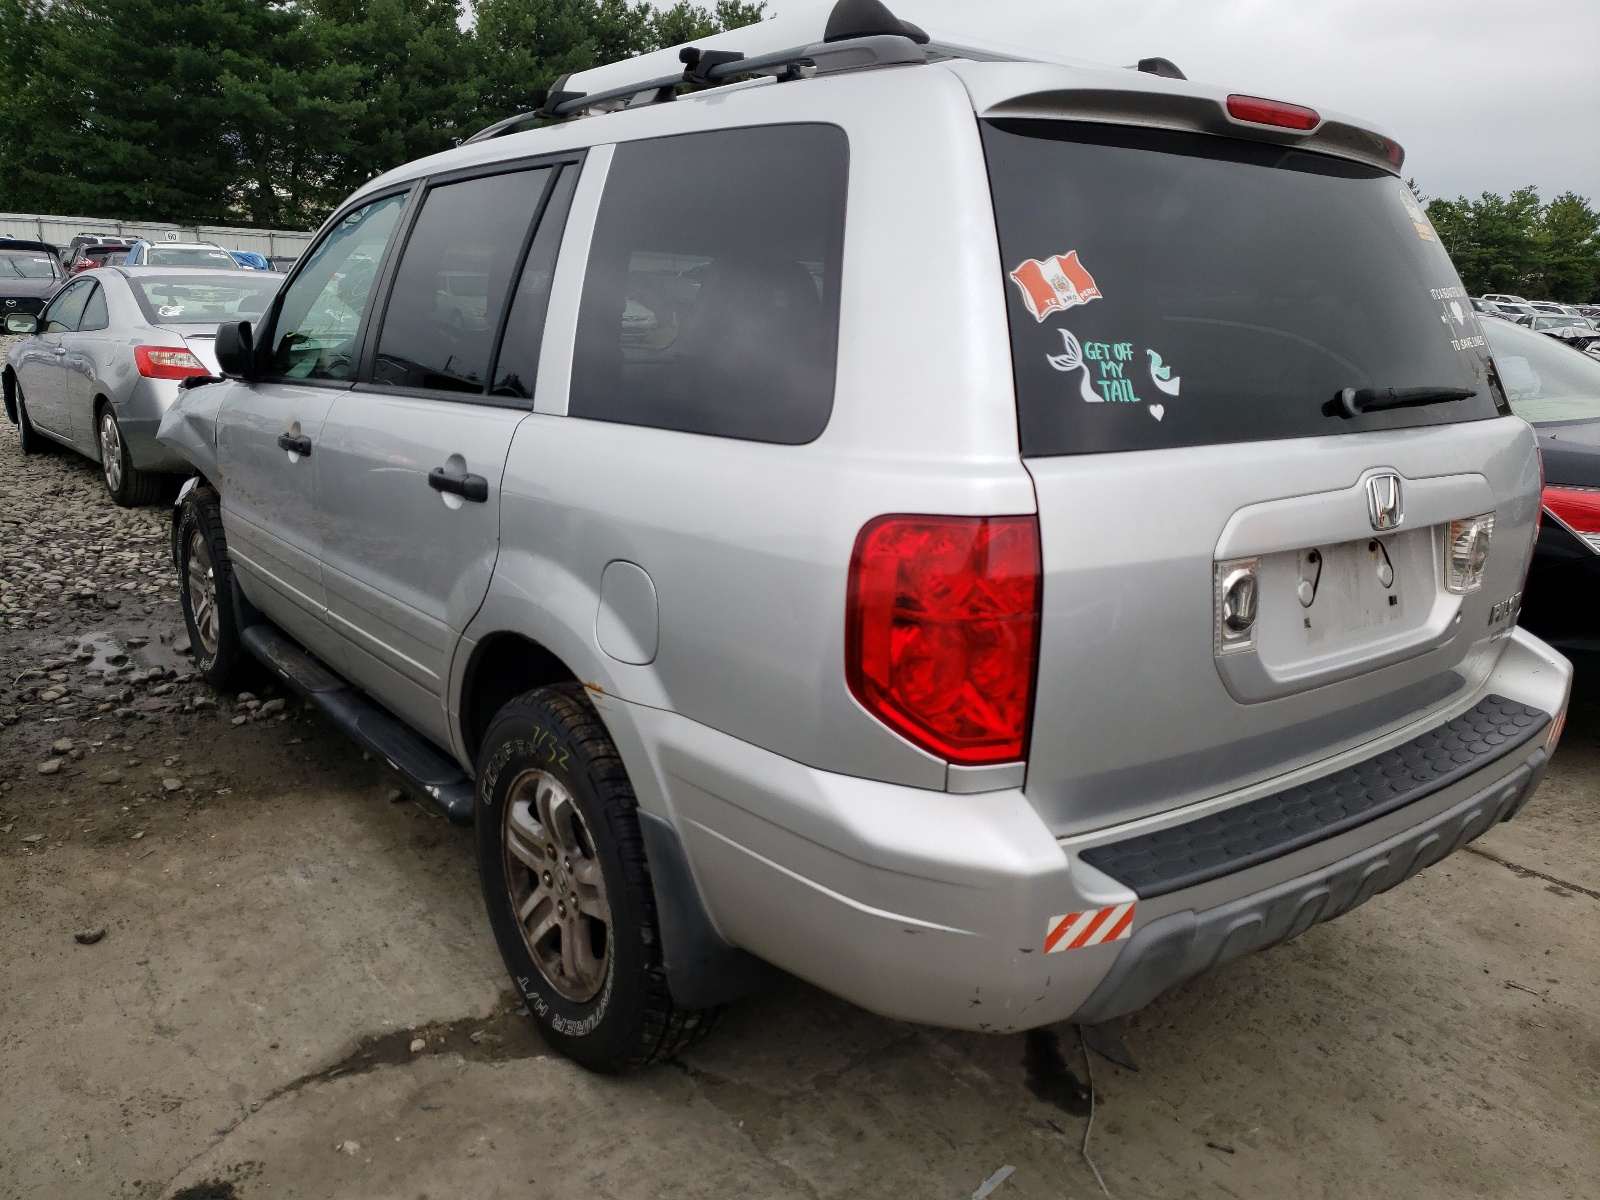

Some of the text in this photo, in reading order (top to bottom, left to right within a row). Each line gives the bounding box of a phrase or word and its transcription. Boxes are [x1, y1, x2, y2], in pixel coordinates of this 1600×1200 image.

[1062, 294, 1077, 303] AMO
[1080, 287, 1096, 299] PERU
[1084, 341, 1134, 361] GET OFF
[1451, 340, 1461, 351] TO
[1460, 337, 1474, 350] SAVE
[1100, 361, 1124, 378] MY
[1097, 379, 1141, 402] TAIL
[481, 739, 541, 805] COOPER
[517, 976, 549, 1017] H/T
